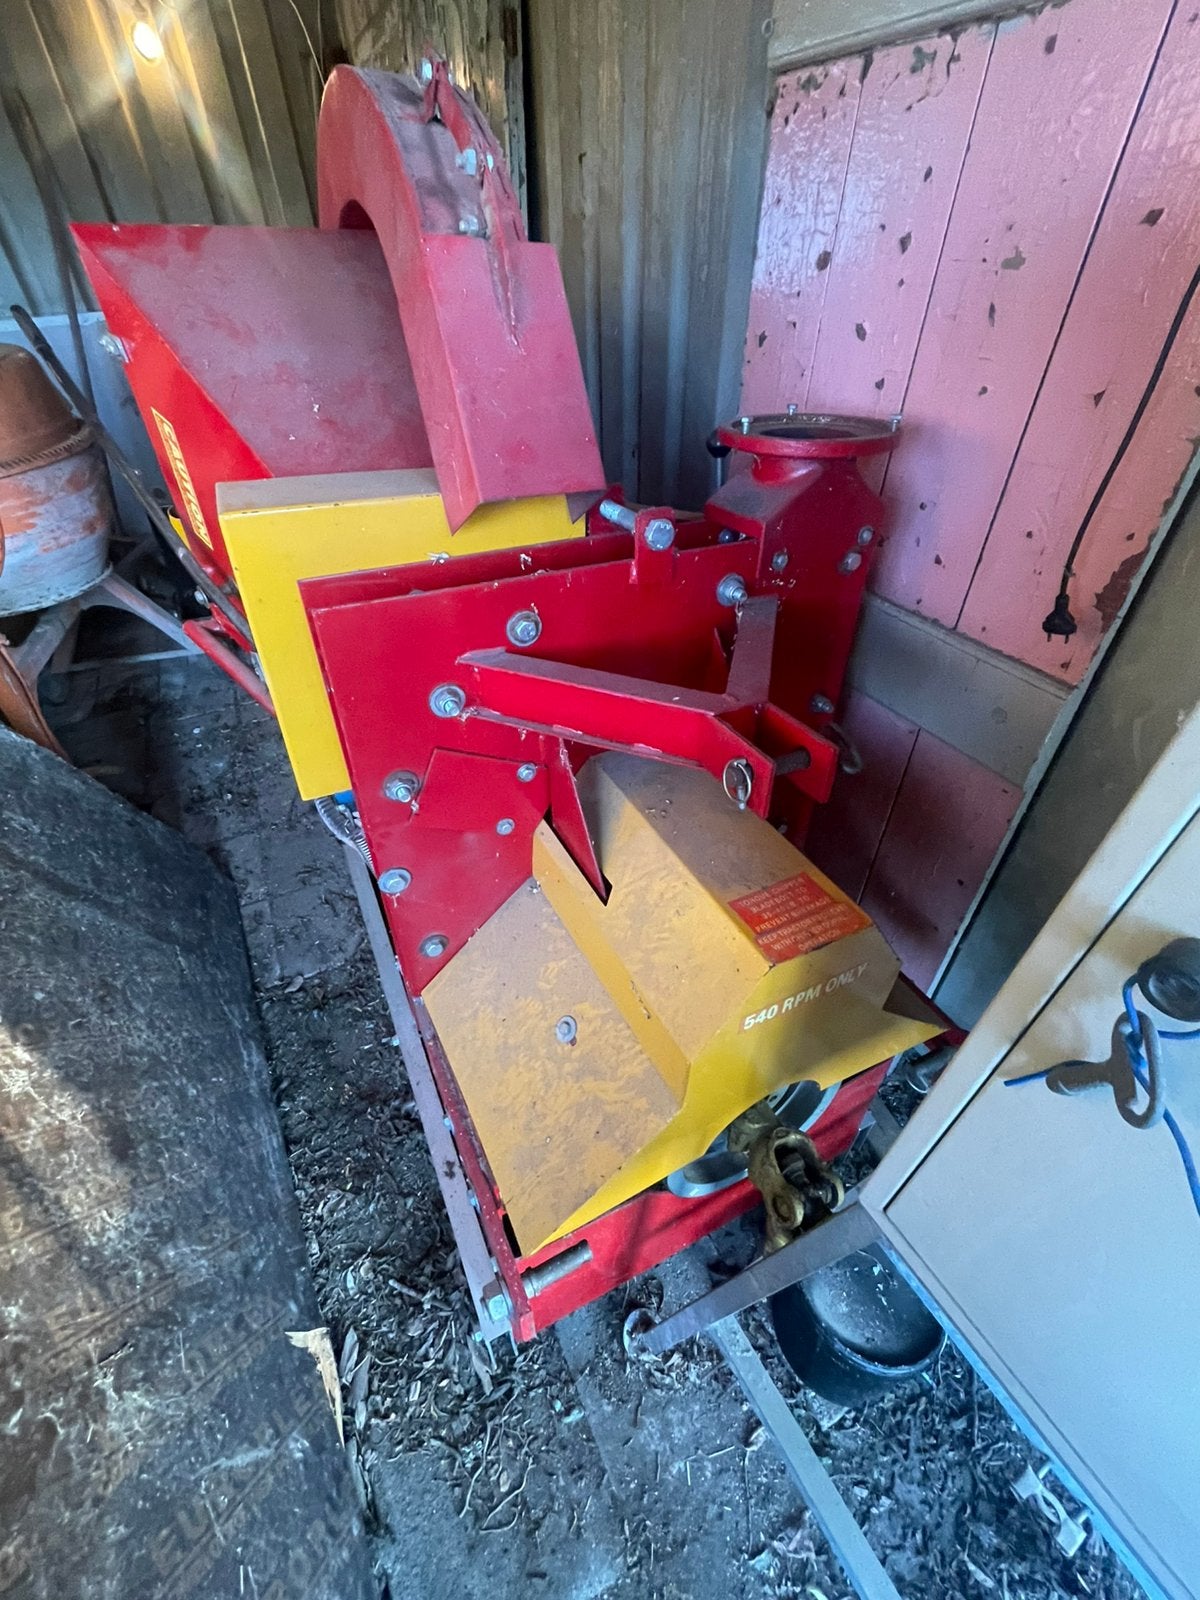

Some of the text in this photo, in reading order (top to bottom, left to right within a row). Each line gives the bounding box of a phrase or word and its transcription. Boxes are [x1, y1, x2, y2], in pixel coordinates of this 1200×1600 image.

[162, 420, 209, 543] CAUTION
[755, 913, 790, 933] PREVENT
[757, 932, 779, 945] KEEP
[779, 917, 812, 937] TRACTOR
[743, 962, 869, 1030] 540 RPM ONLY
